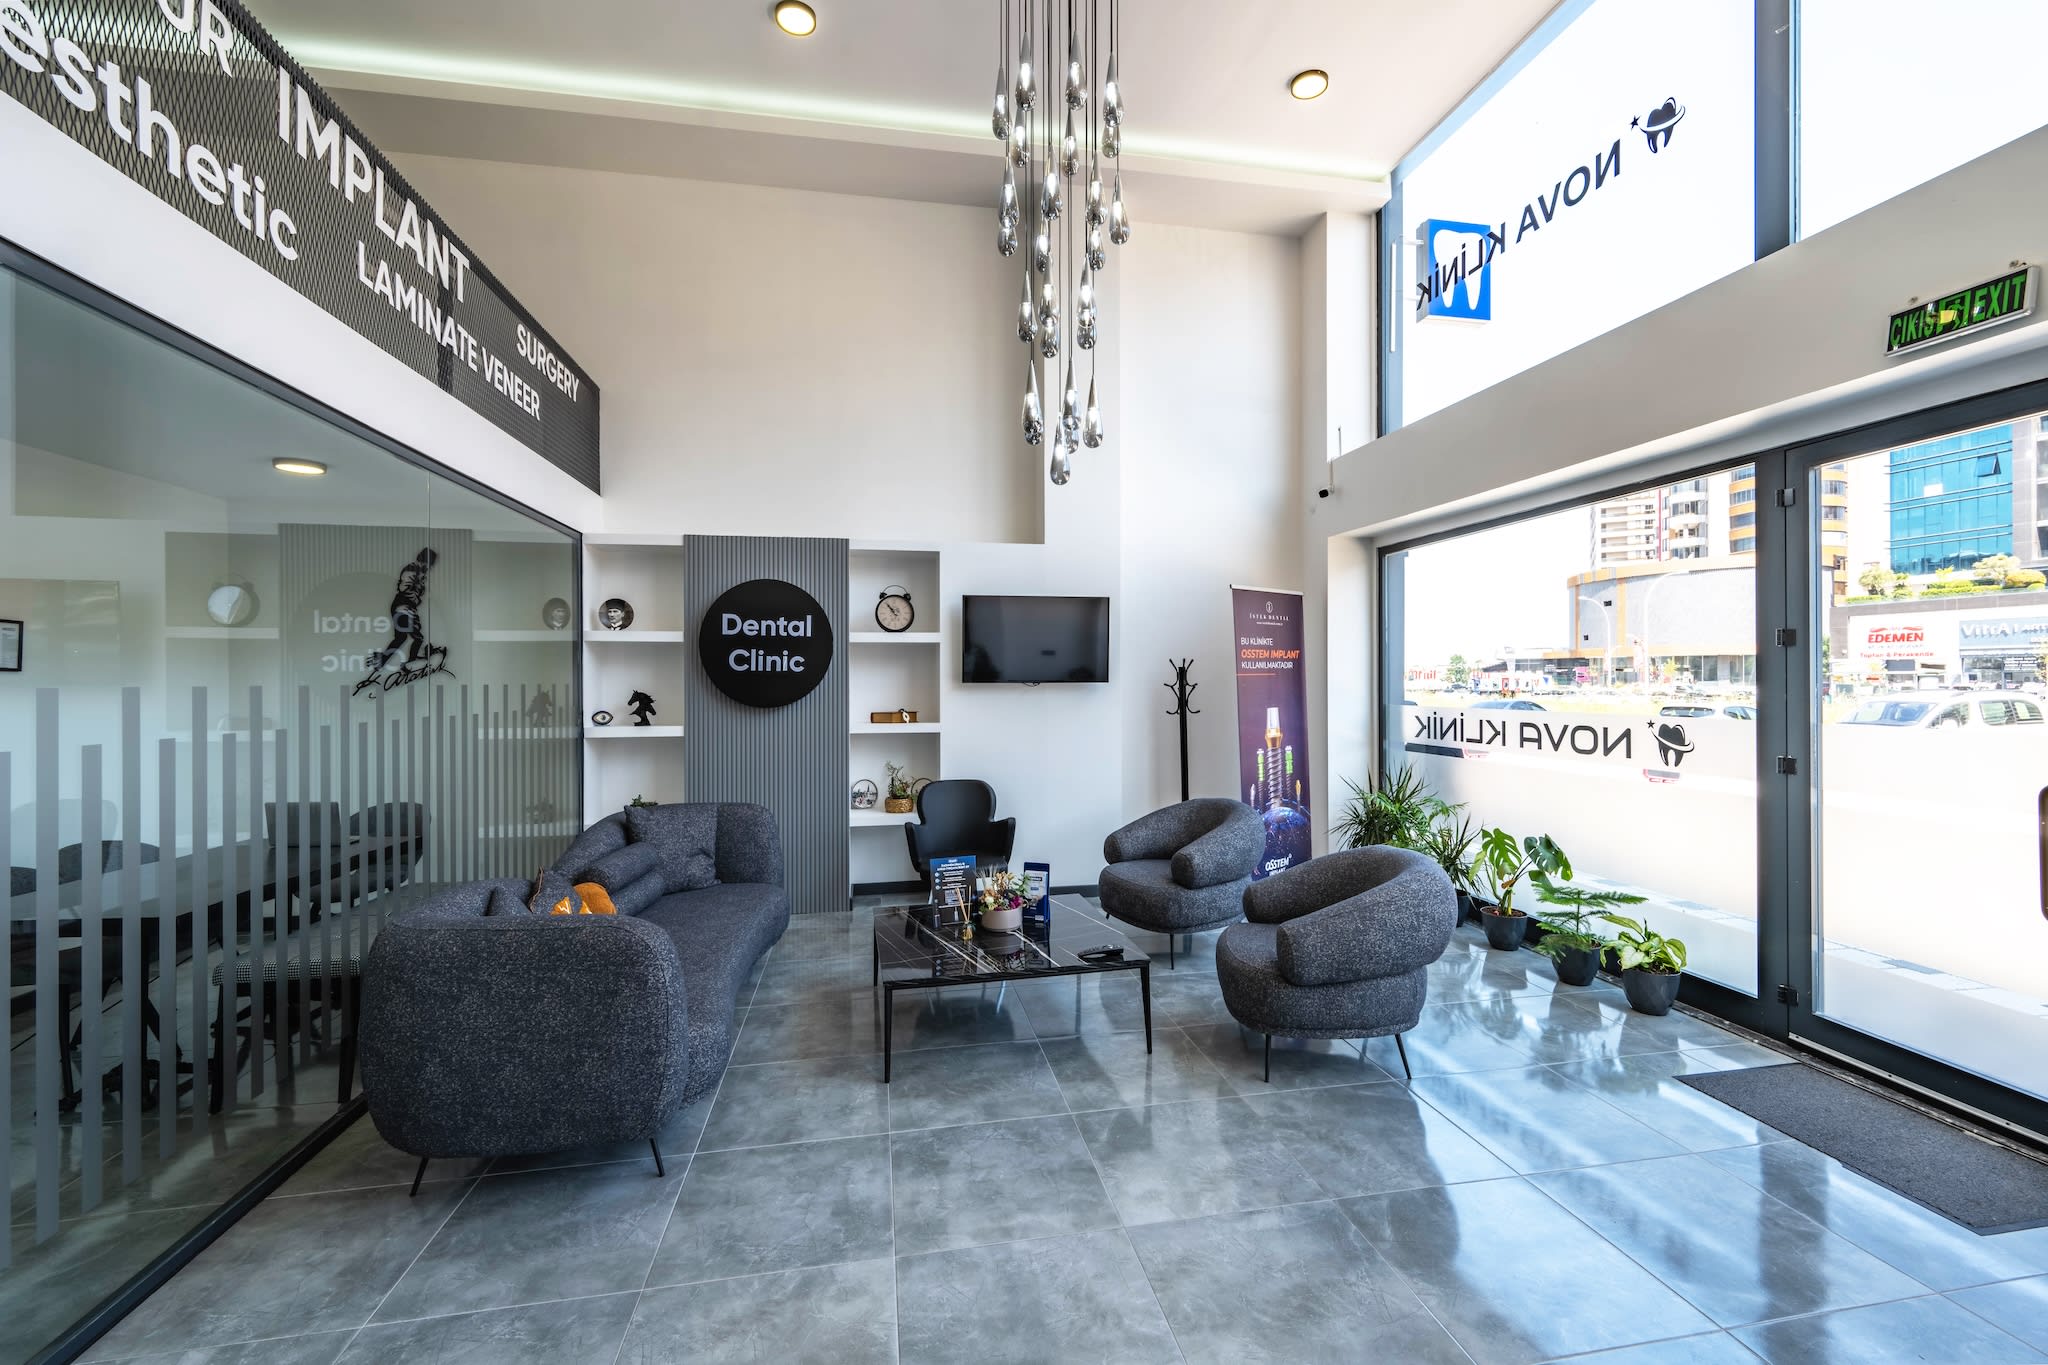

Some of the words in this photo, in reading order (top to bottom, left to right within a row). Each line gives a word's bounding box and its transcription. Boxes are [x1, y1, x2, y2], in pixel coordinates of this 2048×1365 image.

[0, 0, 298, 261] esthetic
[278, 65, 470, 304] IMPLANT
[1973, 274, 2026, 322] EXIT
[358, 240, 478, 373] LAMINATE
[482, 346, 541, 421] VENEER
[516, 323, 580, 403] SURGERY
[721, 612, 812, 637] Dental
[1867, 632, 1925, 644] EDEMEN
[728, 648, 806, 672] Clinic
[1241, 649, 1270, 659] OSSTEM
[1271, 650, 1300, 659] IMPLANT
